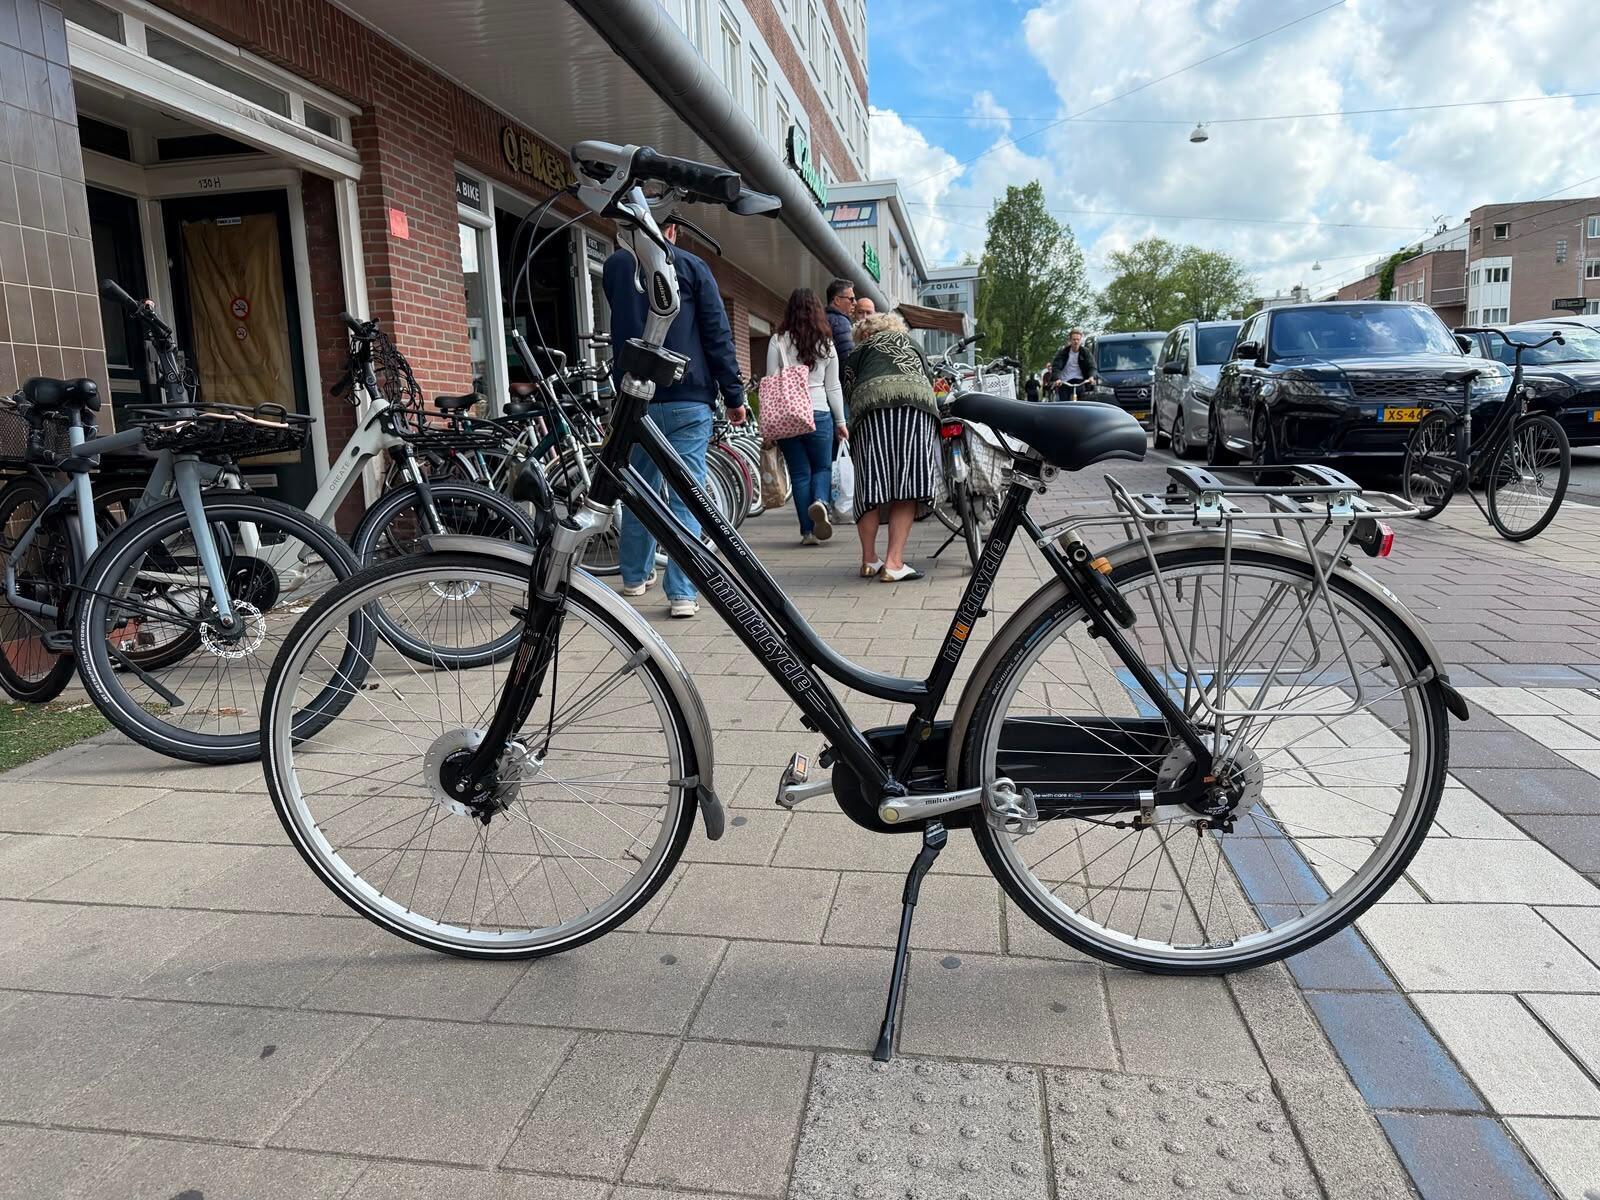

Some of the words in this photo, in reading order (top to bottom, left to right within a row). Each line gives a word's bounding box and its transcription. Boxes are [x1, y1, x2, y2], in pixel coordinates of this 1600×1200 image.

[462, 181, 480, 202] BIKE
[503, 126, 519, 172] Q
[520, 135, 568, 192] BIKES
[691, 486, 721, 524] Intensive
[720, 524, 731, 536] de
[728, 536, 746, 557] Luxe
[706, 573, 812, 692] multicycle
[943, 538, 1007, 663] multicycle
[991, 648, 1025, 696] SCHWALBE
